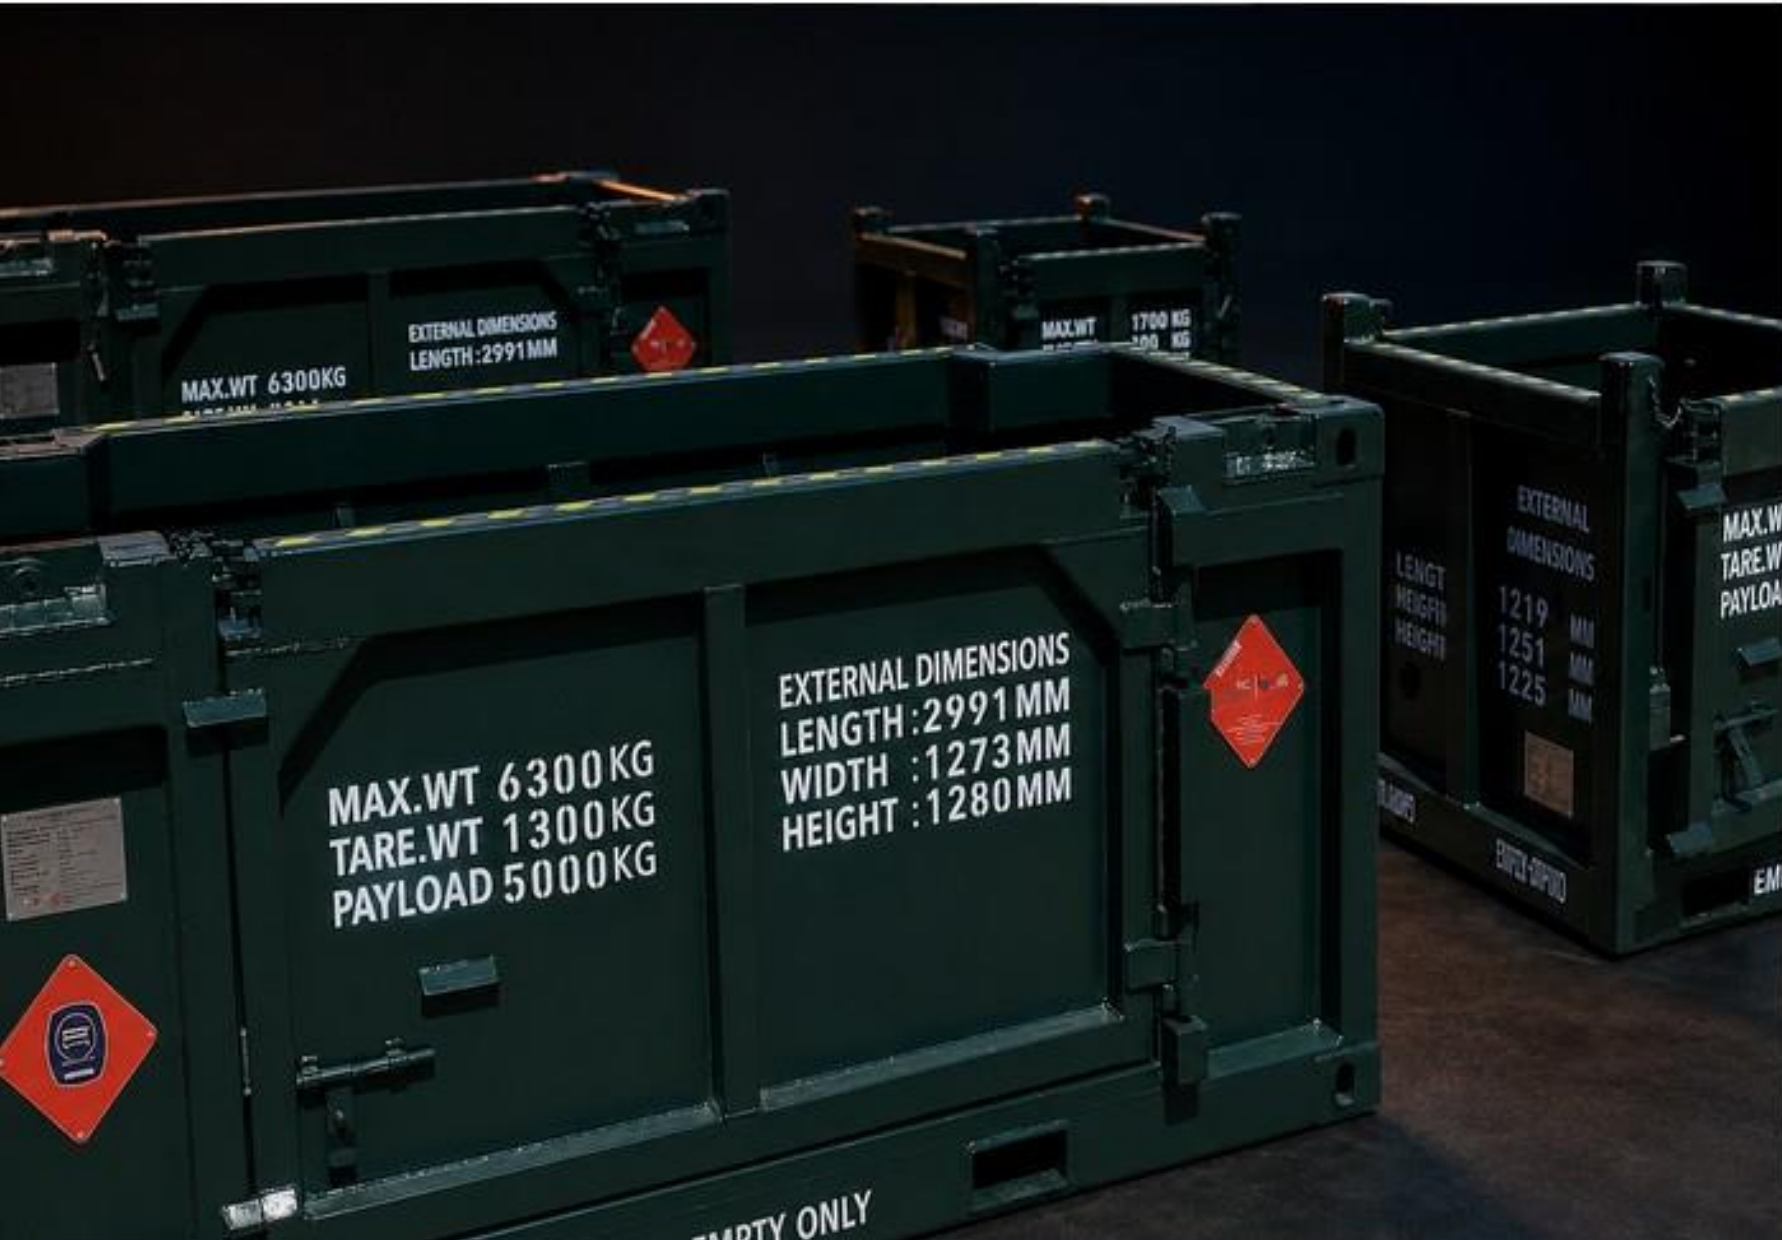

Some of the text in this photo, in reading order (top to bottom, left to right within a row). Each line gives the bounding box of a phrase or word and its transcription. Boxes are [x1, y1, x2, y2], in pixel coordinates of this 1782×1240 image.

[408, 311, 557, 344] EXTERNAL DIMENSIONS
[1041, 316, 1098, 341] MAX.WT
[1170, 309, 1192, 328] KG
[181, 365, 347, 404] MAX.WT 6300KG
[409, 348, 474, 372] LENGTH
[1516, 484, 1590, 534] EXTERNAL
[1506, 525, 1595, 582] DIMENSIONS
[1499, 584, 1549, 629] 1219
[779, 632, 1070, 709] EXTERNAL DIMENSIONS
[1498, 622, 1546, 669] 1251
[1498, 660, 1547, 707] 1225
[780, 703, 904, 758] LENGTH
[328, 764, 481, 827] MAX.WT
[780, 752, 889, 805] WIDTH
[329, 816, 484, 877] TARE.WT
[782, 797, 899, 852] HEIGHT
[332, 867, 494, 929] PAYLOAD
[796, 1188, 872, 1240] ONLY
